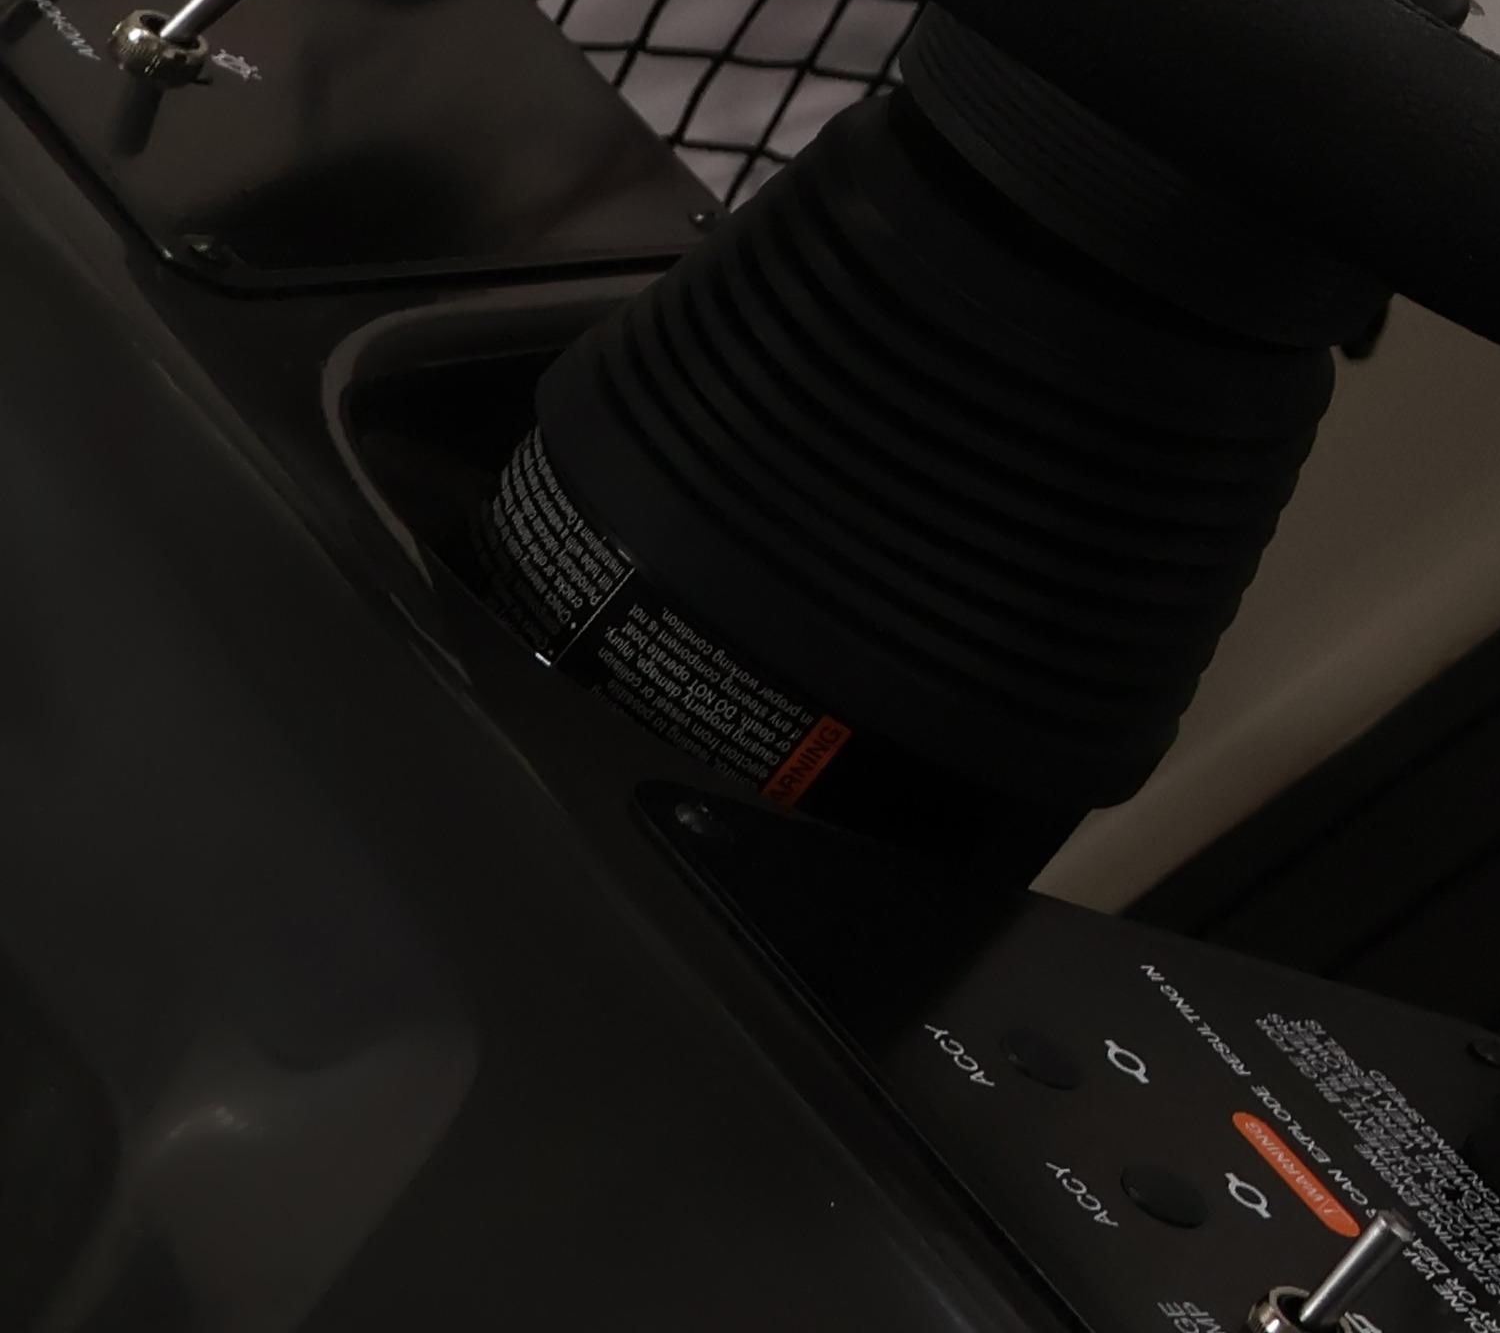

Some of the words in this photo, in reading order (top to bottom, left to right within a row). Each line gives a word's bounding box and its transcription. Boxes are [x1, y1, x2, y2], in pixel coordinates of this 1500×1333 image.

[924, 1022, 995, 1089] ACCY
[1159, 984, 1251, 1075] RESULTING
[1244, 1121, 1324, 1201] WARNING
[1250, 1085, 1331, 1163] EXPLODE
[1045, 1160, 1119, 1230] ACCY
[1353, 1143, 1421, 1206] ENGINE
